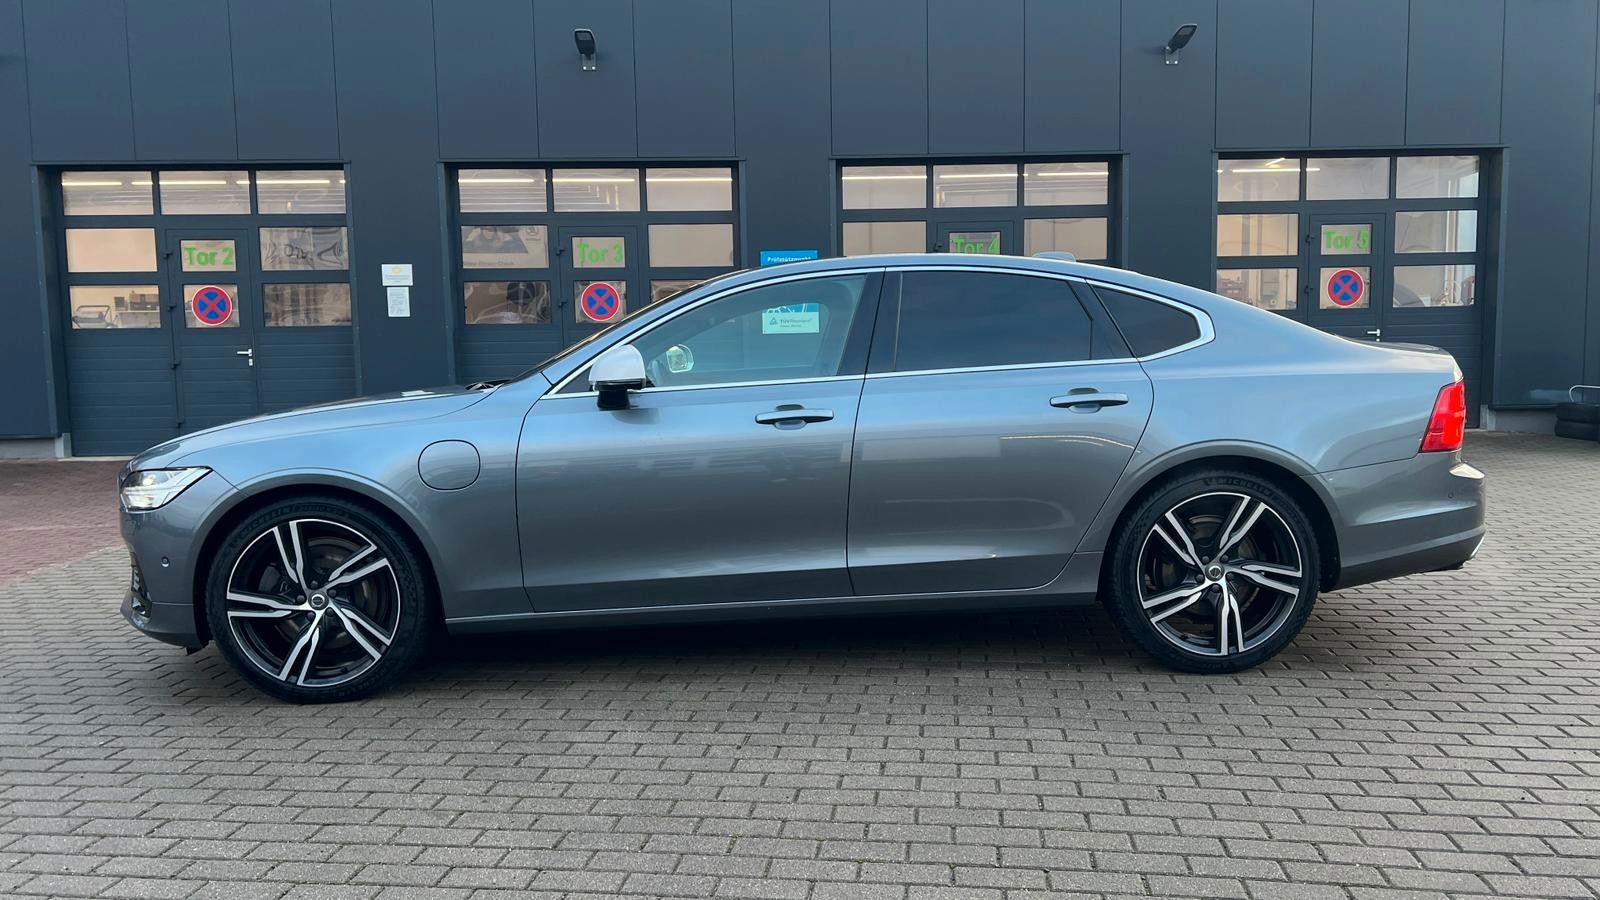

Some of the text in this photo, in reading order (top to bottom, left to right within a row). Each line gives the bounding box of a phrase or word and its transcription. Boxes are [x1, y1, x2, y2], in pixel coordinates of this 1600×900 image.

[953, 238, 998, 255] Tor 4
[1325, 228, 1370, 250] Tor 5
[184, 245, 234, 266] Tor 2
[576, 240, 624, 264] Tor 3
